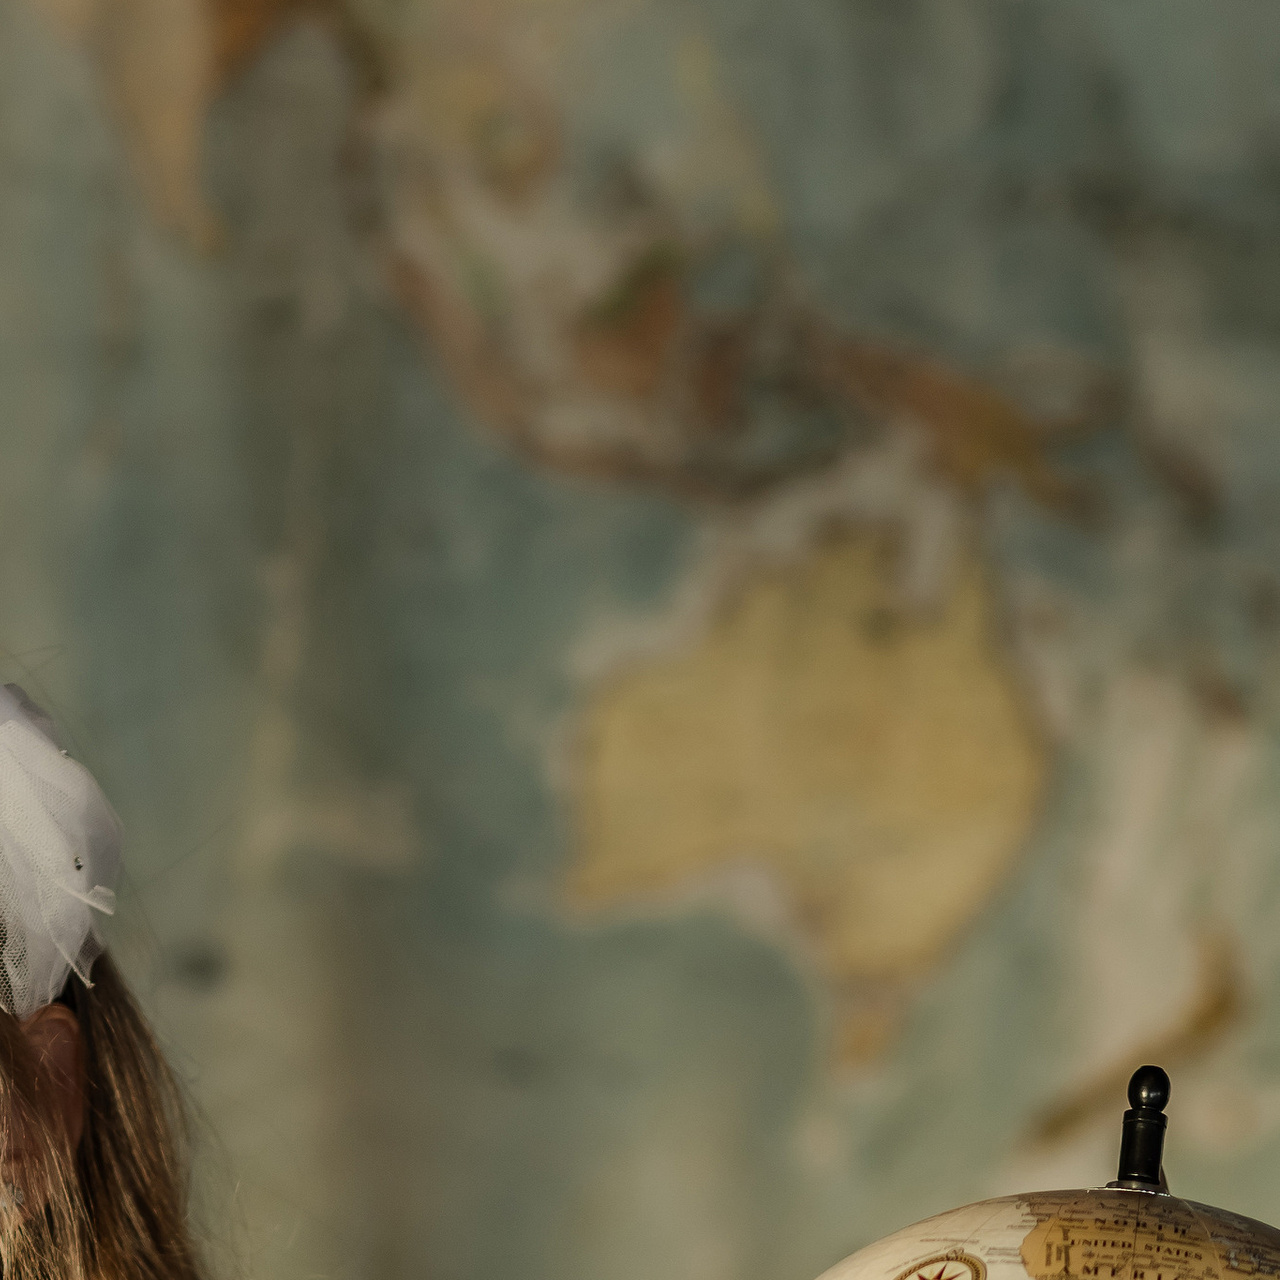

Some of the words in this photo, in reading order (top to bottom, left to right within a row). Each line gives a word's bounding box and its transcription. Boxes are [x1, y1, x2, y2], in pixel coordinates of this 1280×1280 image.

[1094, 1217, 1187, 1237] NORTH
[1070, 1239, 1132, 1249] UNITED
[1144, 1243, 1203, 1260] STATES
